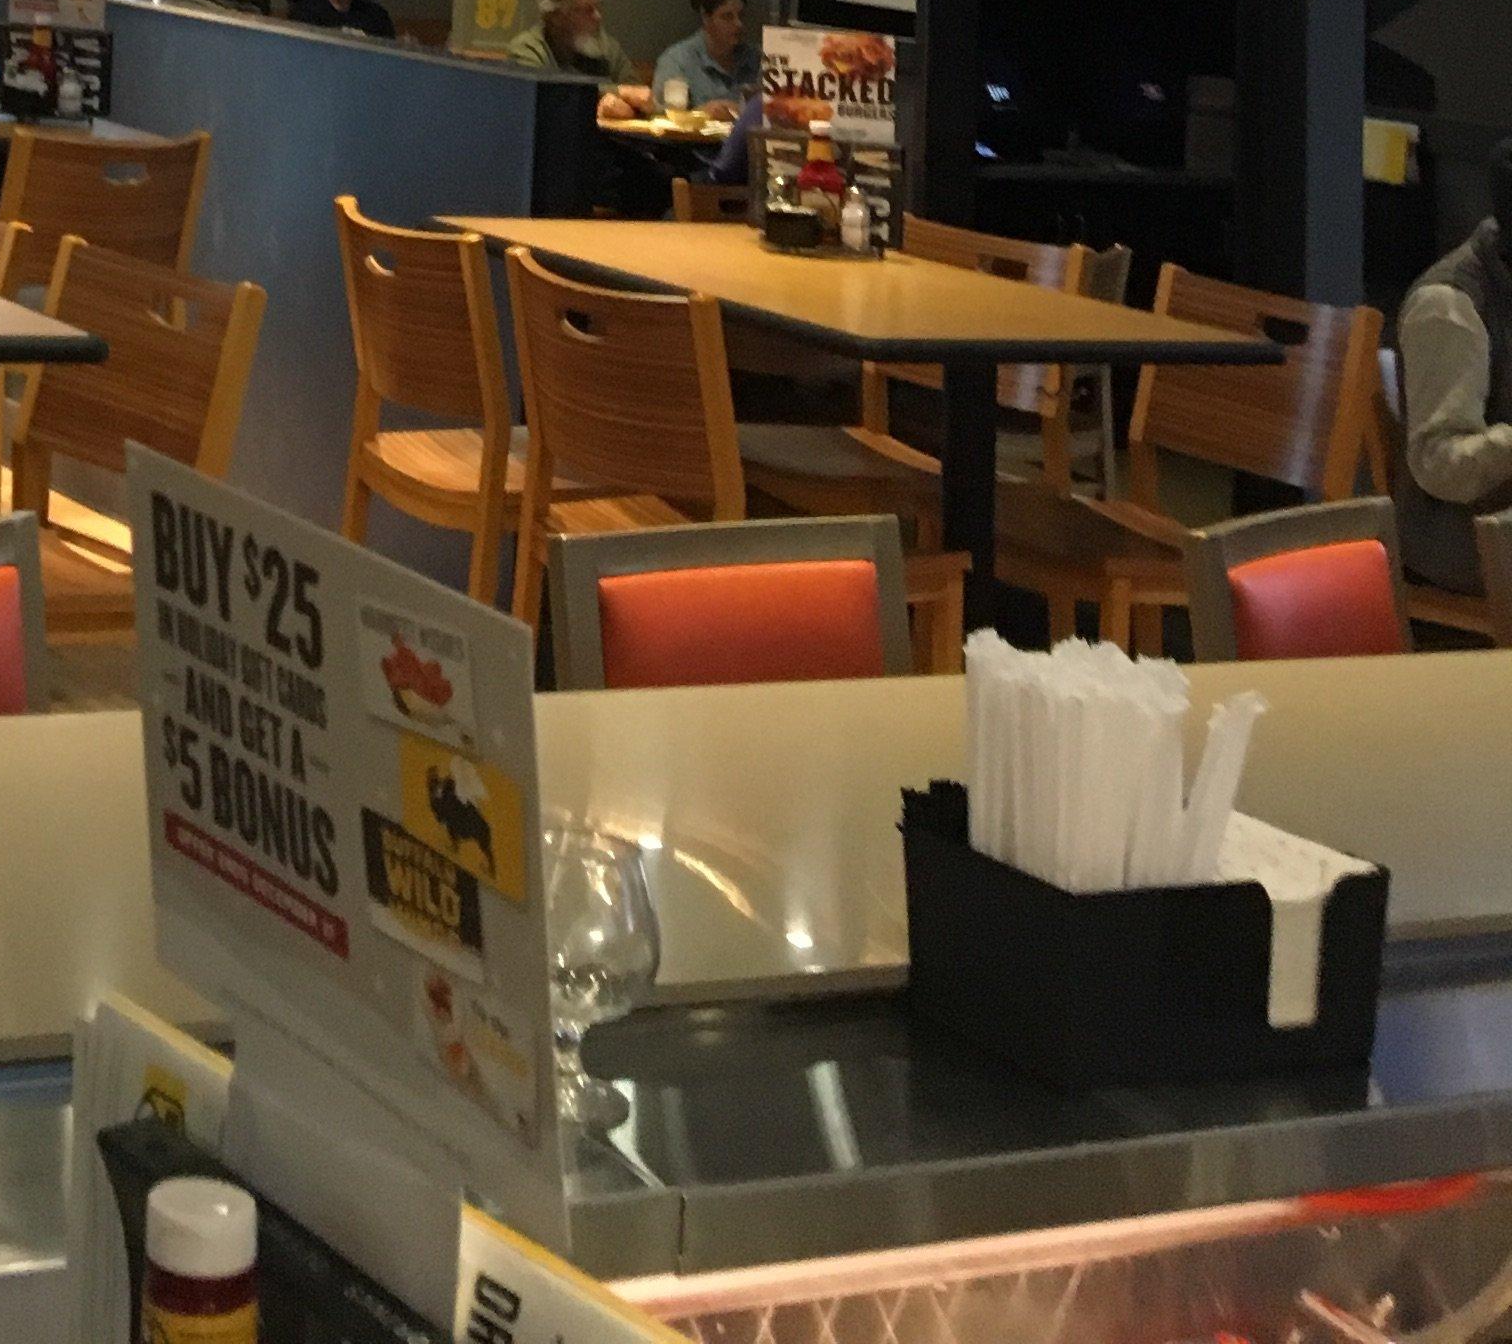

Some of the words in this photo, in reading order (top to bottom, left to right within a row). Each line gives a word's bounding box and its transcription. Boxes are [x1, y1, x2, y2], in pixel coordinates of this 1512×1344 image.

[761, 67, 895, 106] STACKED
[150, 488, 235, 624] BUY
[242, 531, 325, 670] $25
[185, 663, 233, 739] AND
[238, 694, 282, 769] GET
[291, 724, 307, 785] A
[162, 714, 203, 812] $5
[209, 742, 340, 898] BONUS
[386, 853, 461, 927] WILD
